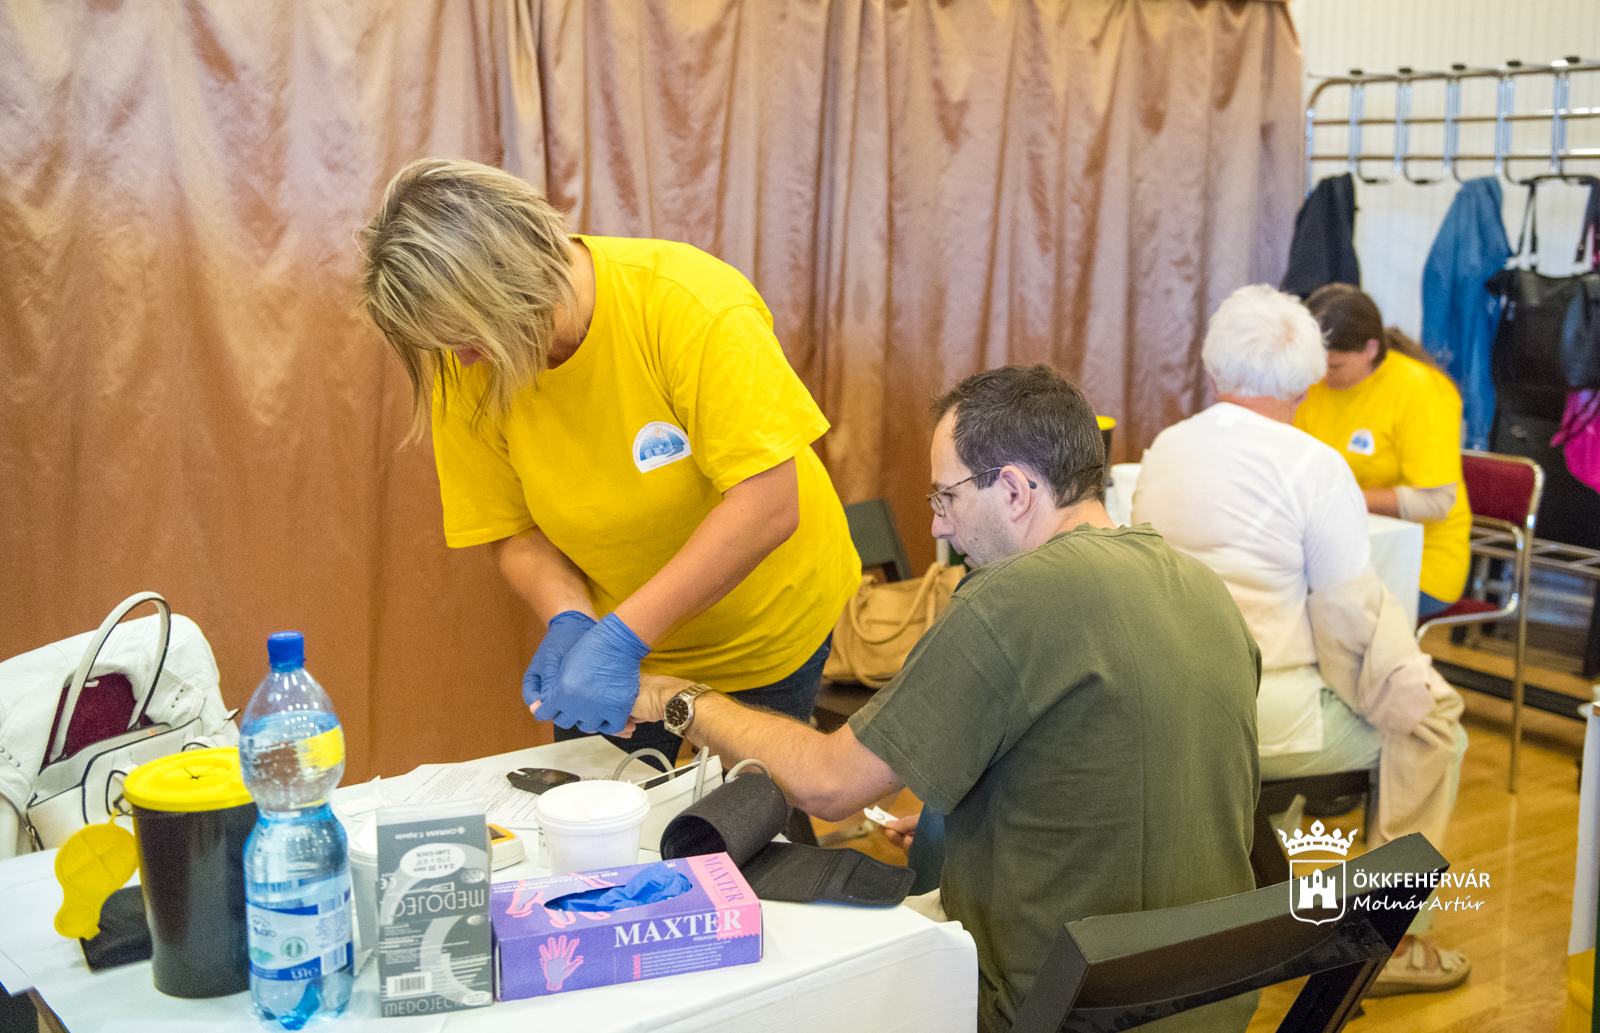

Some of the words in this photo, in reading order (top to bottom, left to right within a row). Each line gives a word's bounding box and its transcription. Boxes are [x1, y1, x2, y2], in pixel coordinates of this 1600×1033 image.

[700, 854, 746, 903] MAXTER
[614, 908, 742, 948] MAXTER
[692, 933, 719, 942] PREMIUM
[719, 930, 743, 939] QUALITY
